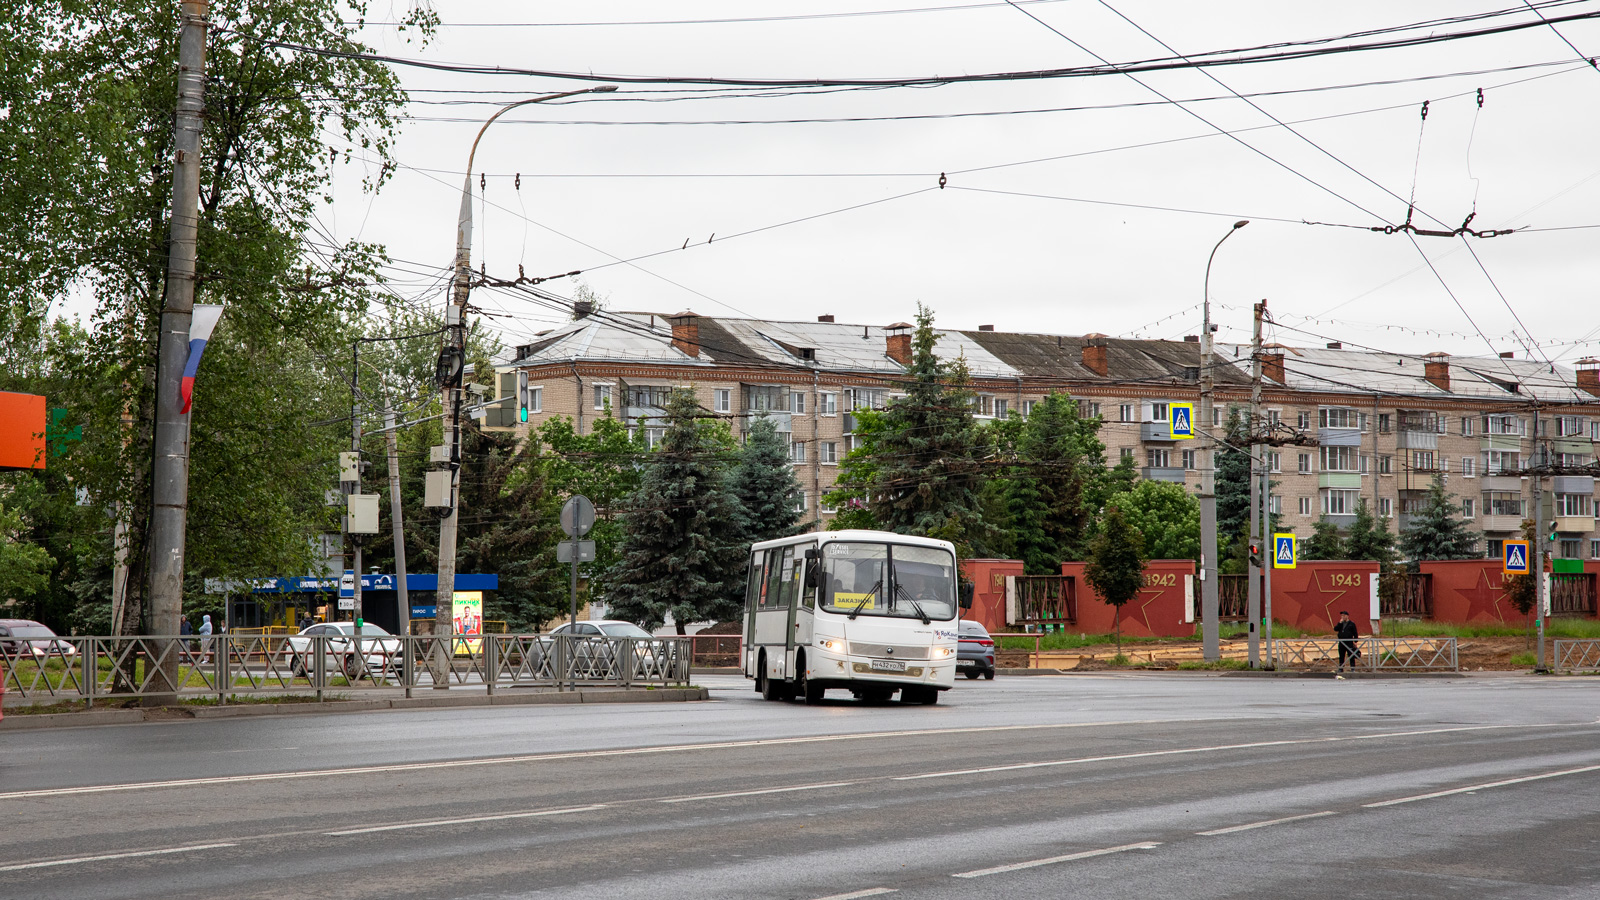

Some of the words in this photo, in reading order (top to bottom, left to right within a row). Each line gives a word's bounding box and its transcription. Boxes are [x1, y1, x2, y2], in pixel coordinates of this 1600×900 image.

[1146, 573, 1177, 587] 1942
[1330, 573, 1361, 587] 1943
[1500, 572, 1515, 583] 19
